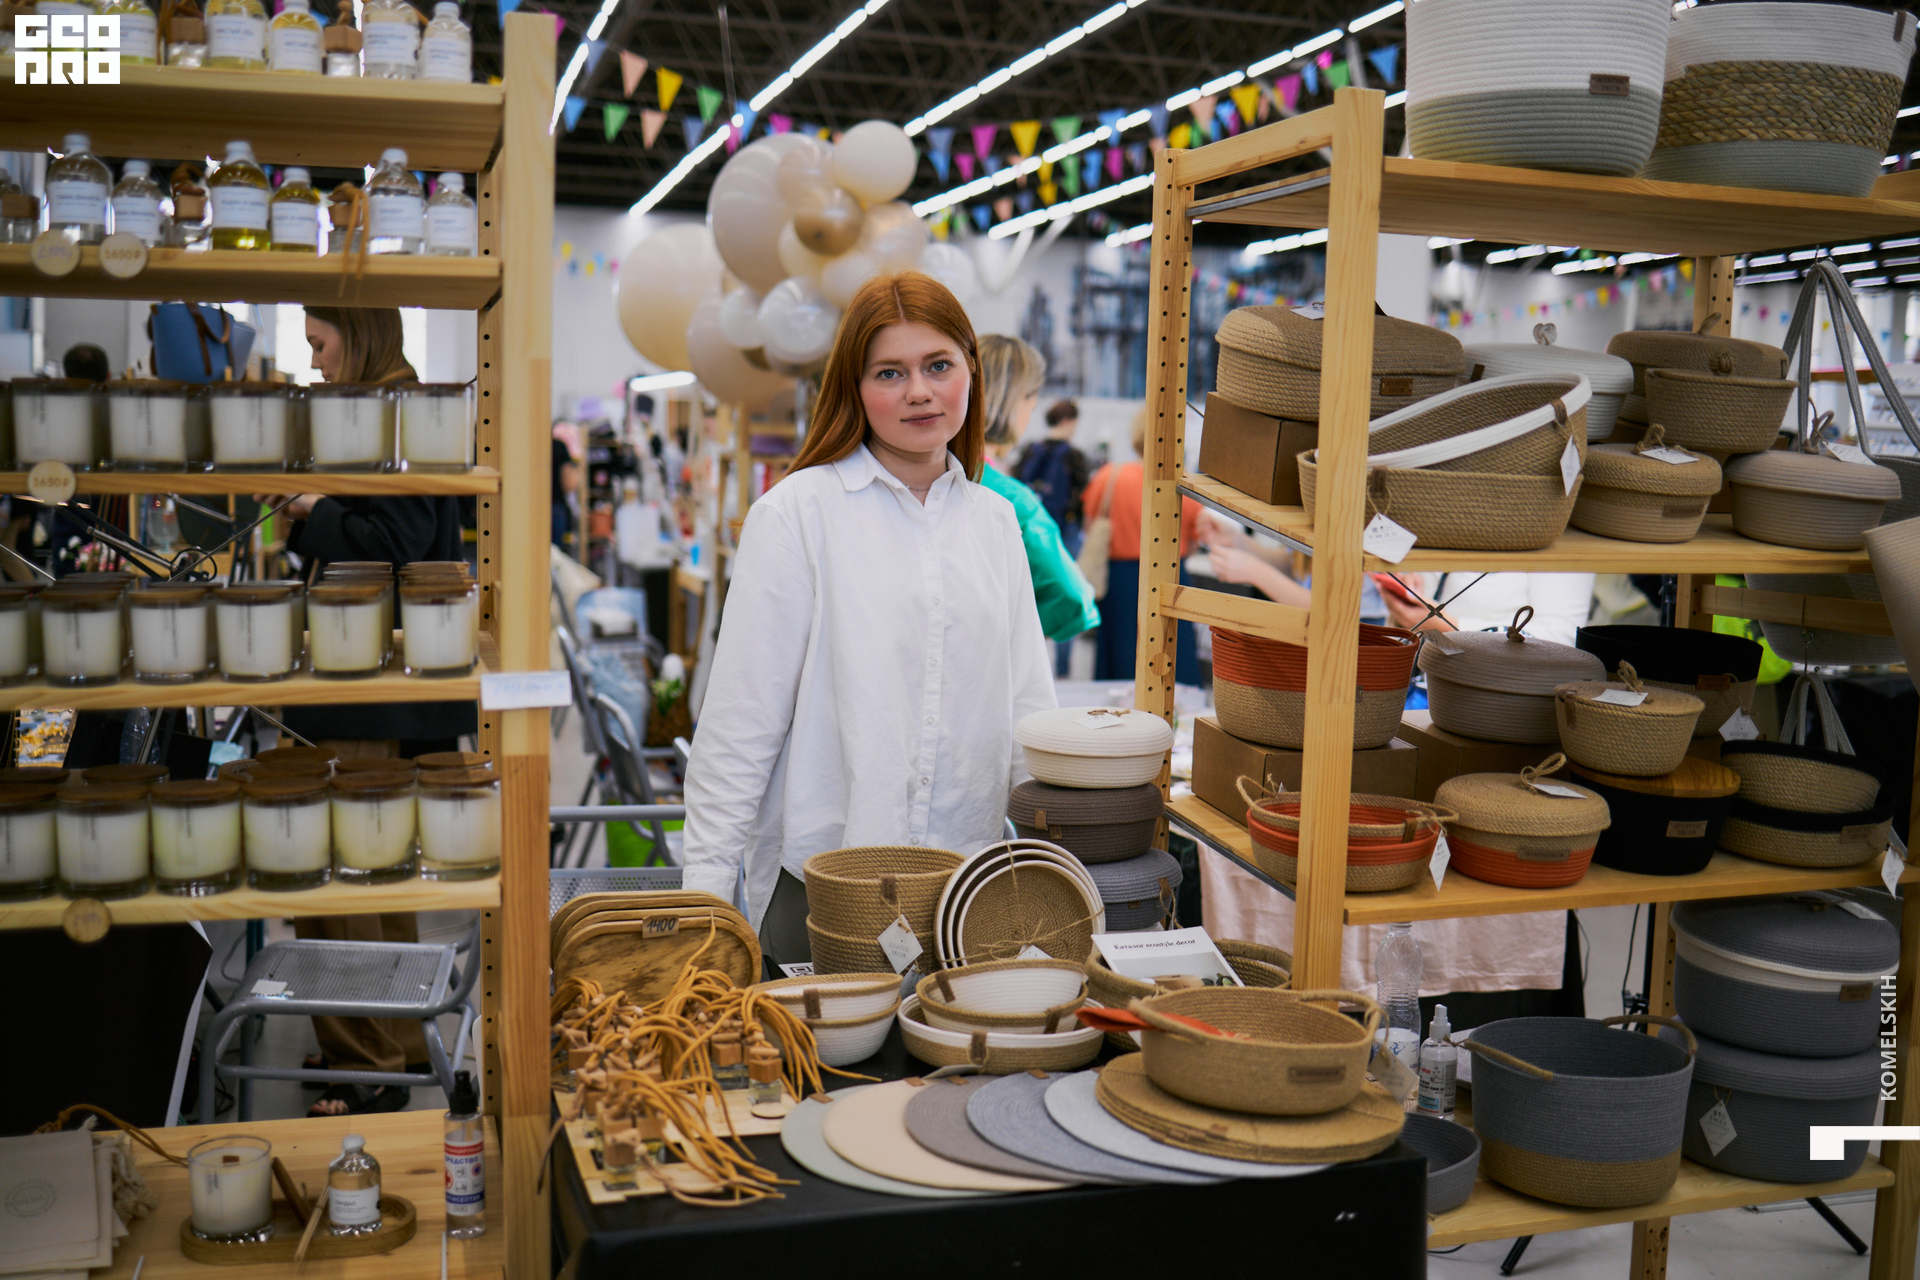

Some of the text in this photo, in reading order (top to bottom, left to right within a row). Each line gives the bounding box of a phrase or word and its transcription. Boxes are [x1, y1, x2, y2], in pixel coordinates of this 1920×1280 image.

[647, 918, 676, 933] 1400
[888, 943, 910, 953] ECOSTYLE
[1145, 939, 1196, 948] ecostyle.decor
[892, 950, 906, 958] DECOR
